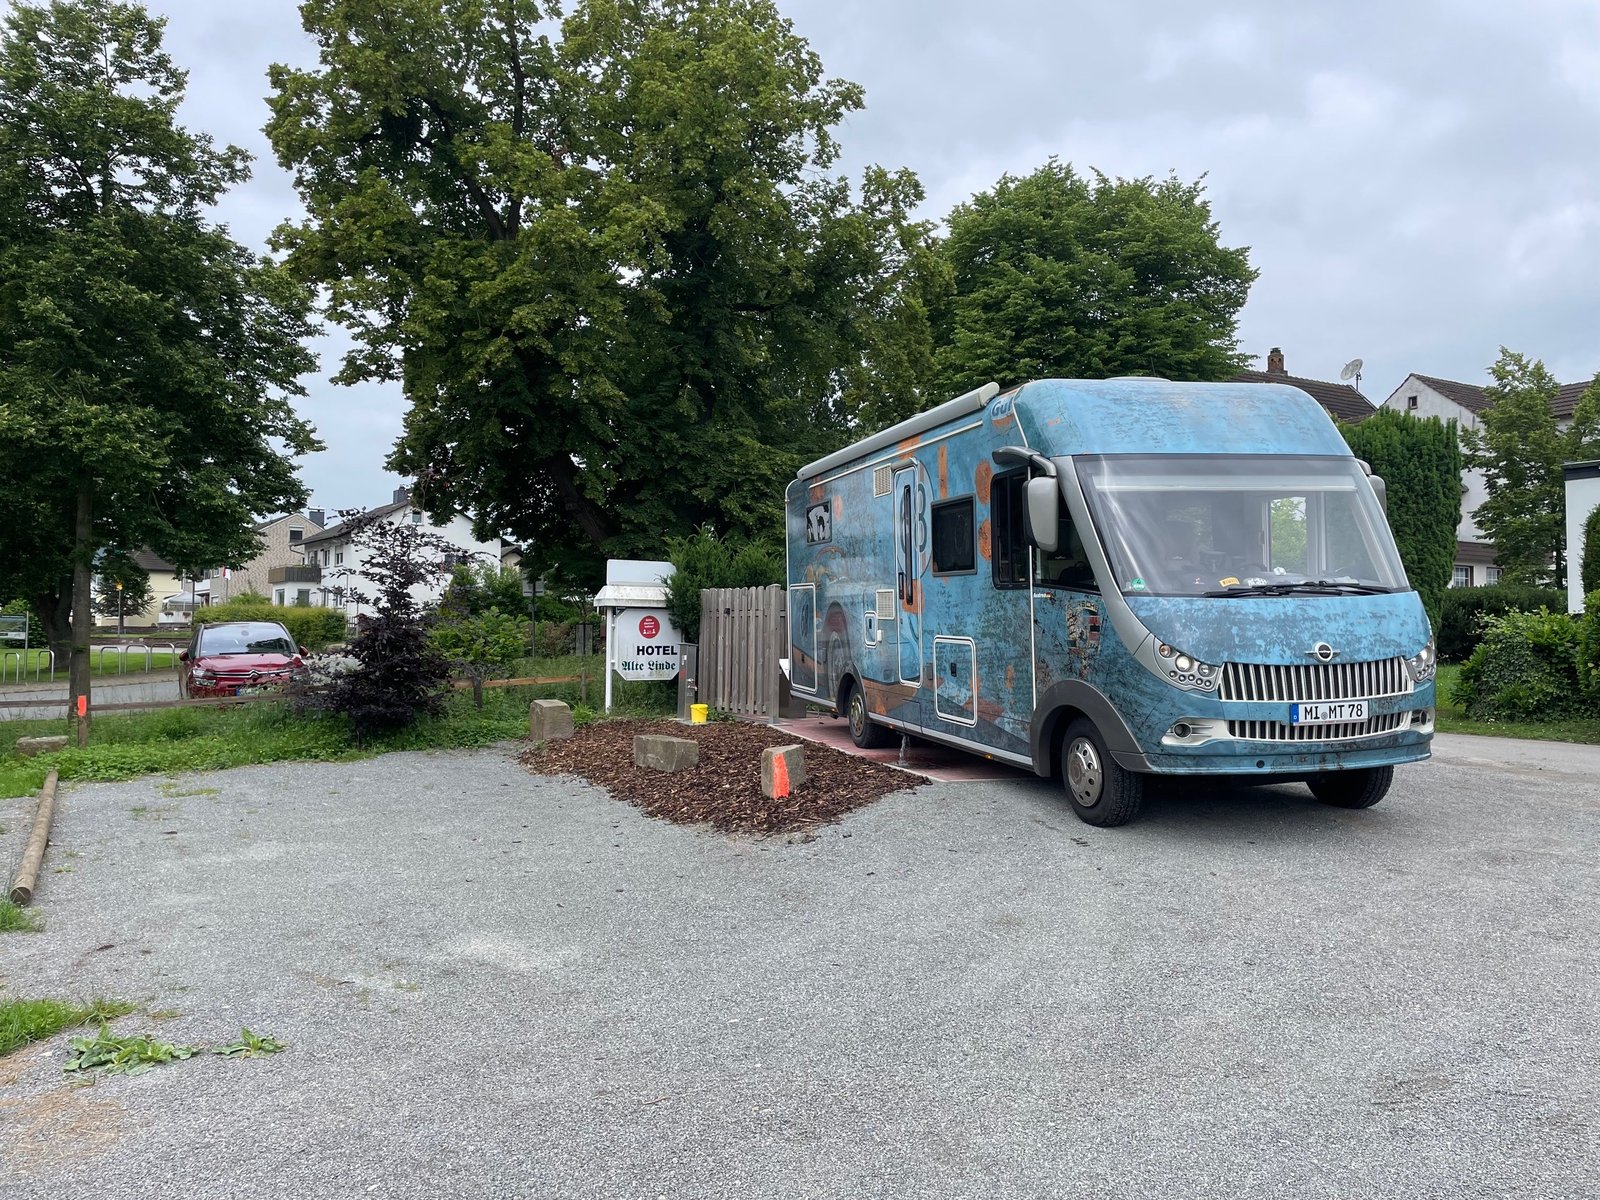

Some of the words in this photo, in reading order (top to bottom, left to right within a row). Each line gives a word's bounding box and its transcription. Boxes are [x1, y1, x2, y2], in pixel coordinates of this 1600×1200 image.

[637, 645, 678, 656] HOTEL
[621, 660, 645, 671] Alte
[648, 660, 676, 671] Linde
[1304, 705, 1320, 720] MI
[1328, 704, 1345, 719] MT
[1348, 703, 1363, 718] 78
